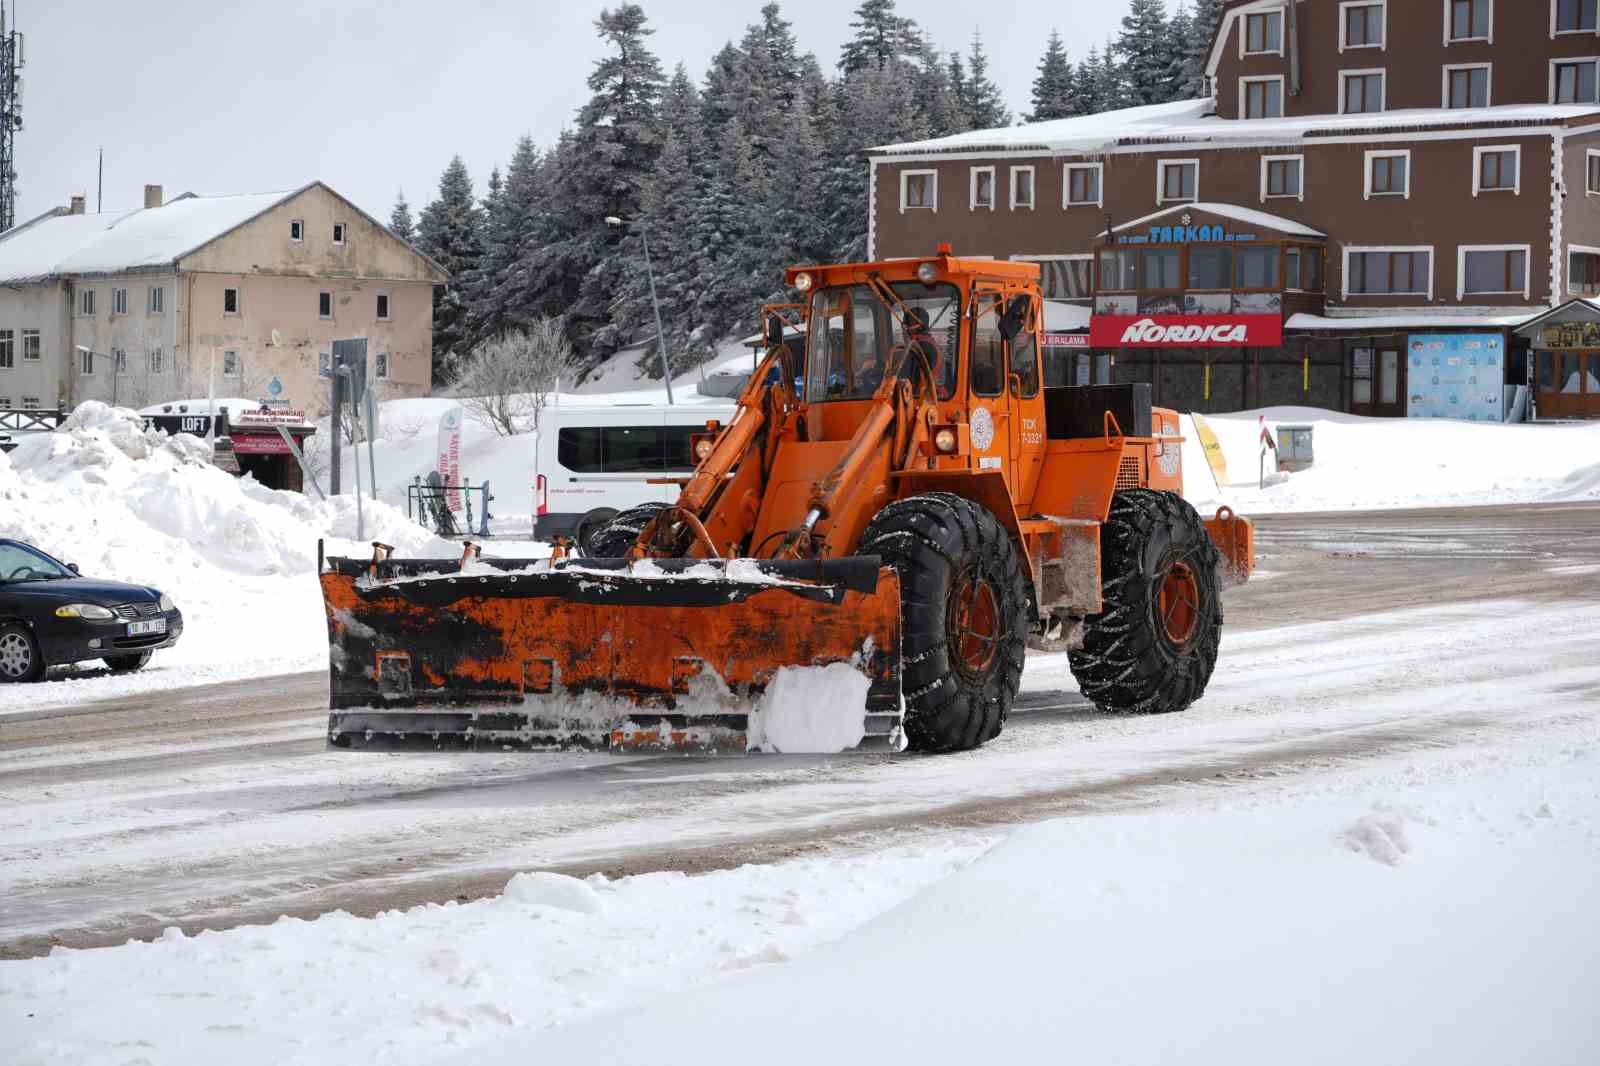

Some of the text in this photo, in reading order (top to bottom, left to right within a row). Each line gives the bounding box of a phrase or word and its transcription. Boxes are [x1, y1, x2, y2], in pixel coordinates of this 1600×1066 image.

[1150, 224, 1225, 243] TARKAN
[1120, 318, 1249, 343] NORDICA
[181, 417, 205, 431] LOFT
